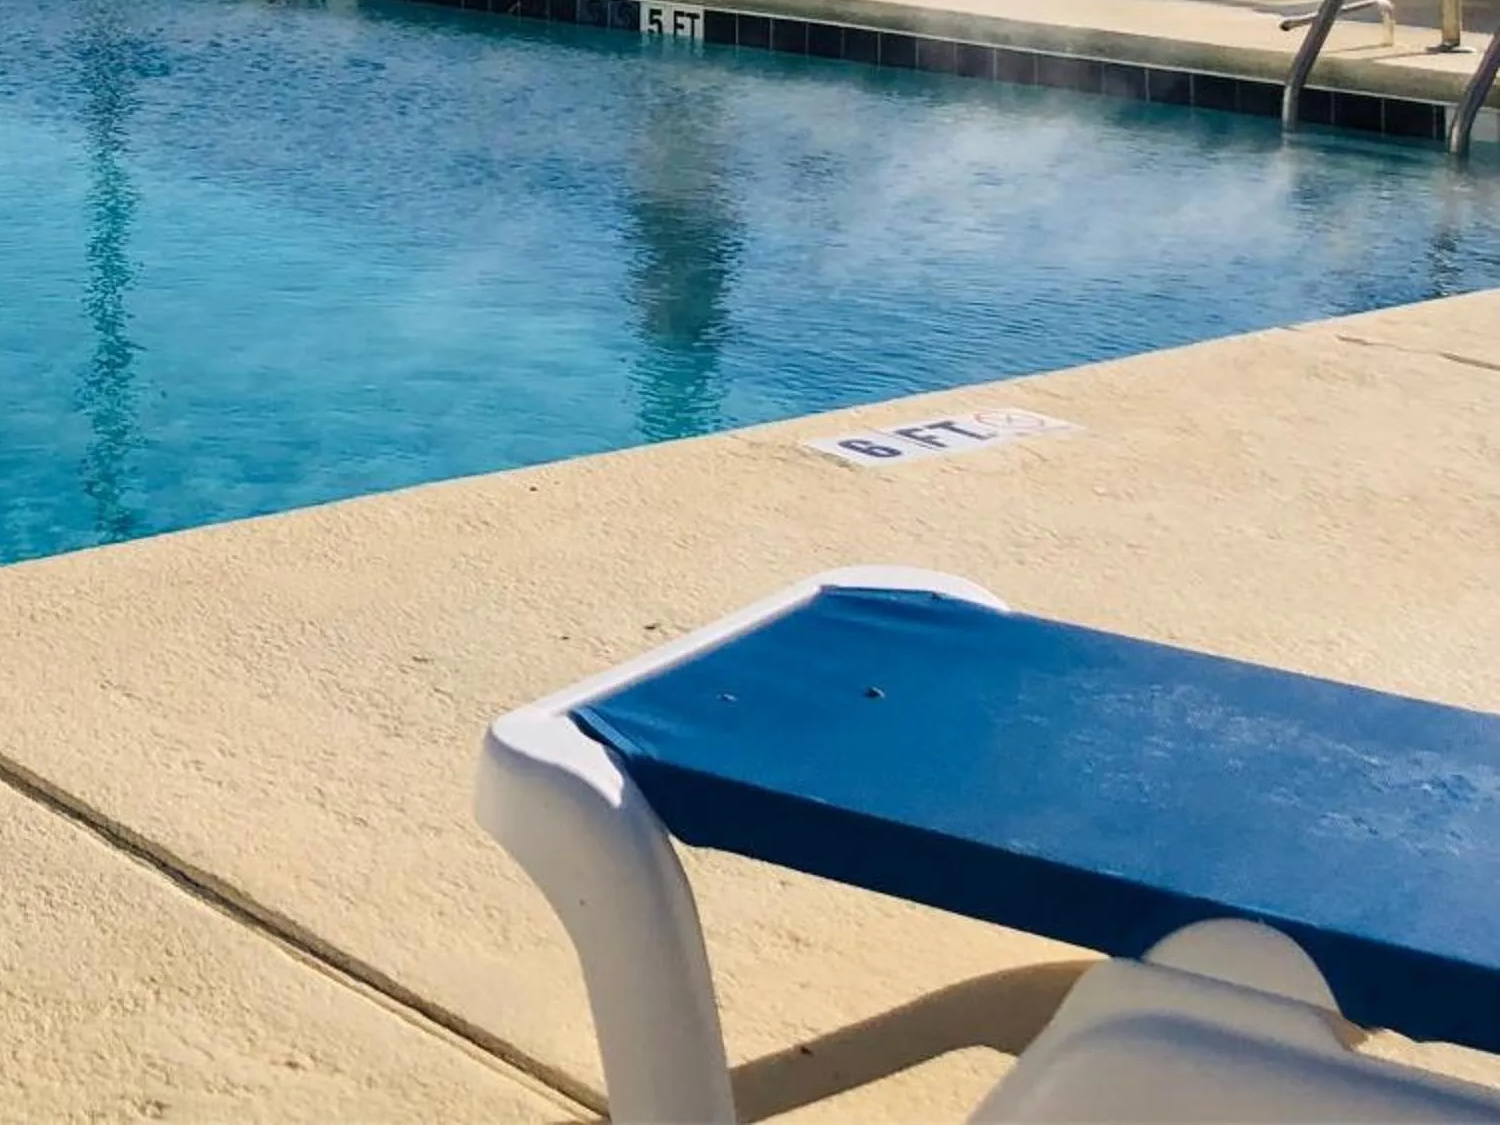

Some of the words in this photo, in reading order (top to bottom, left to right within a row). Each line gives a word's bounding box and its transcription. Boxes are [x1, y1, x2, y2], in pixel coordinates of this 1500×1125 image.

[647, 9, 663, 35] 5
[673, 11, 700, 39] FT
[838, 438, 902, 458] 6
[896, 420, 990, 448] FT
